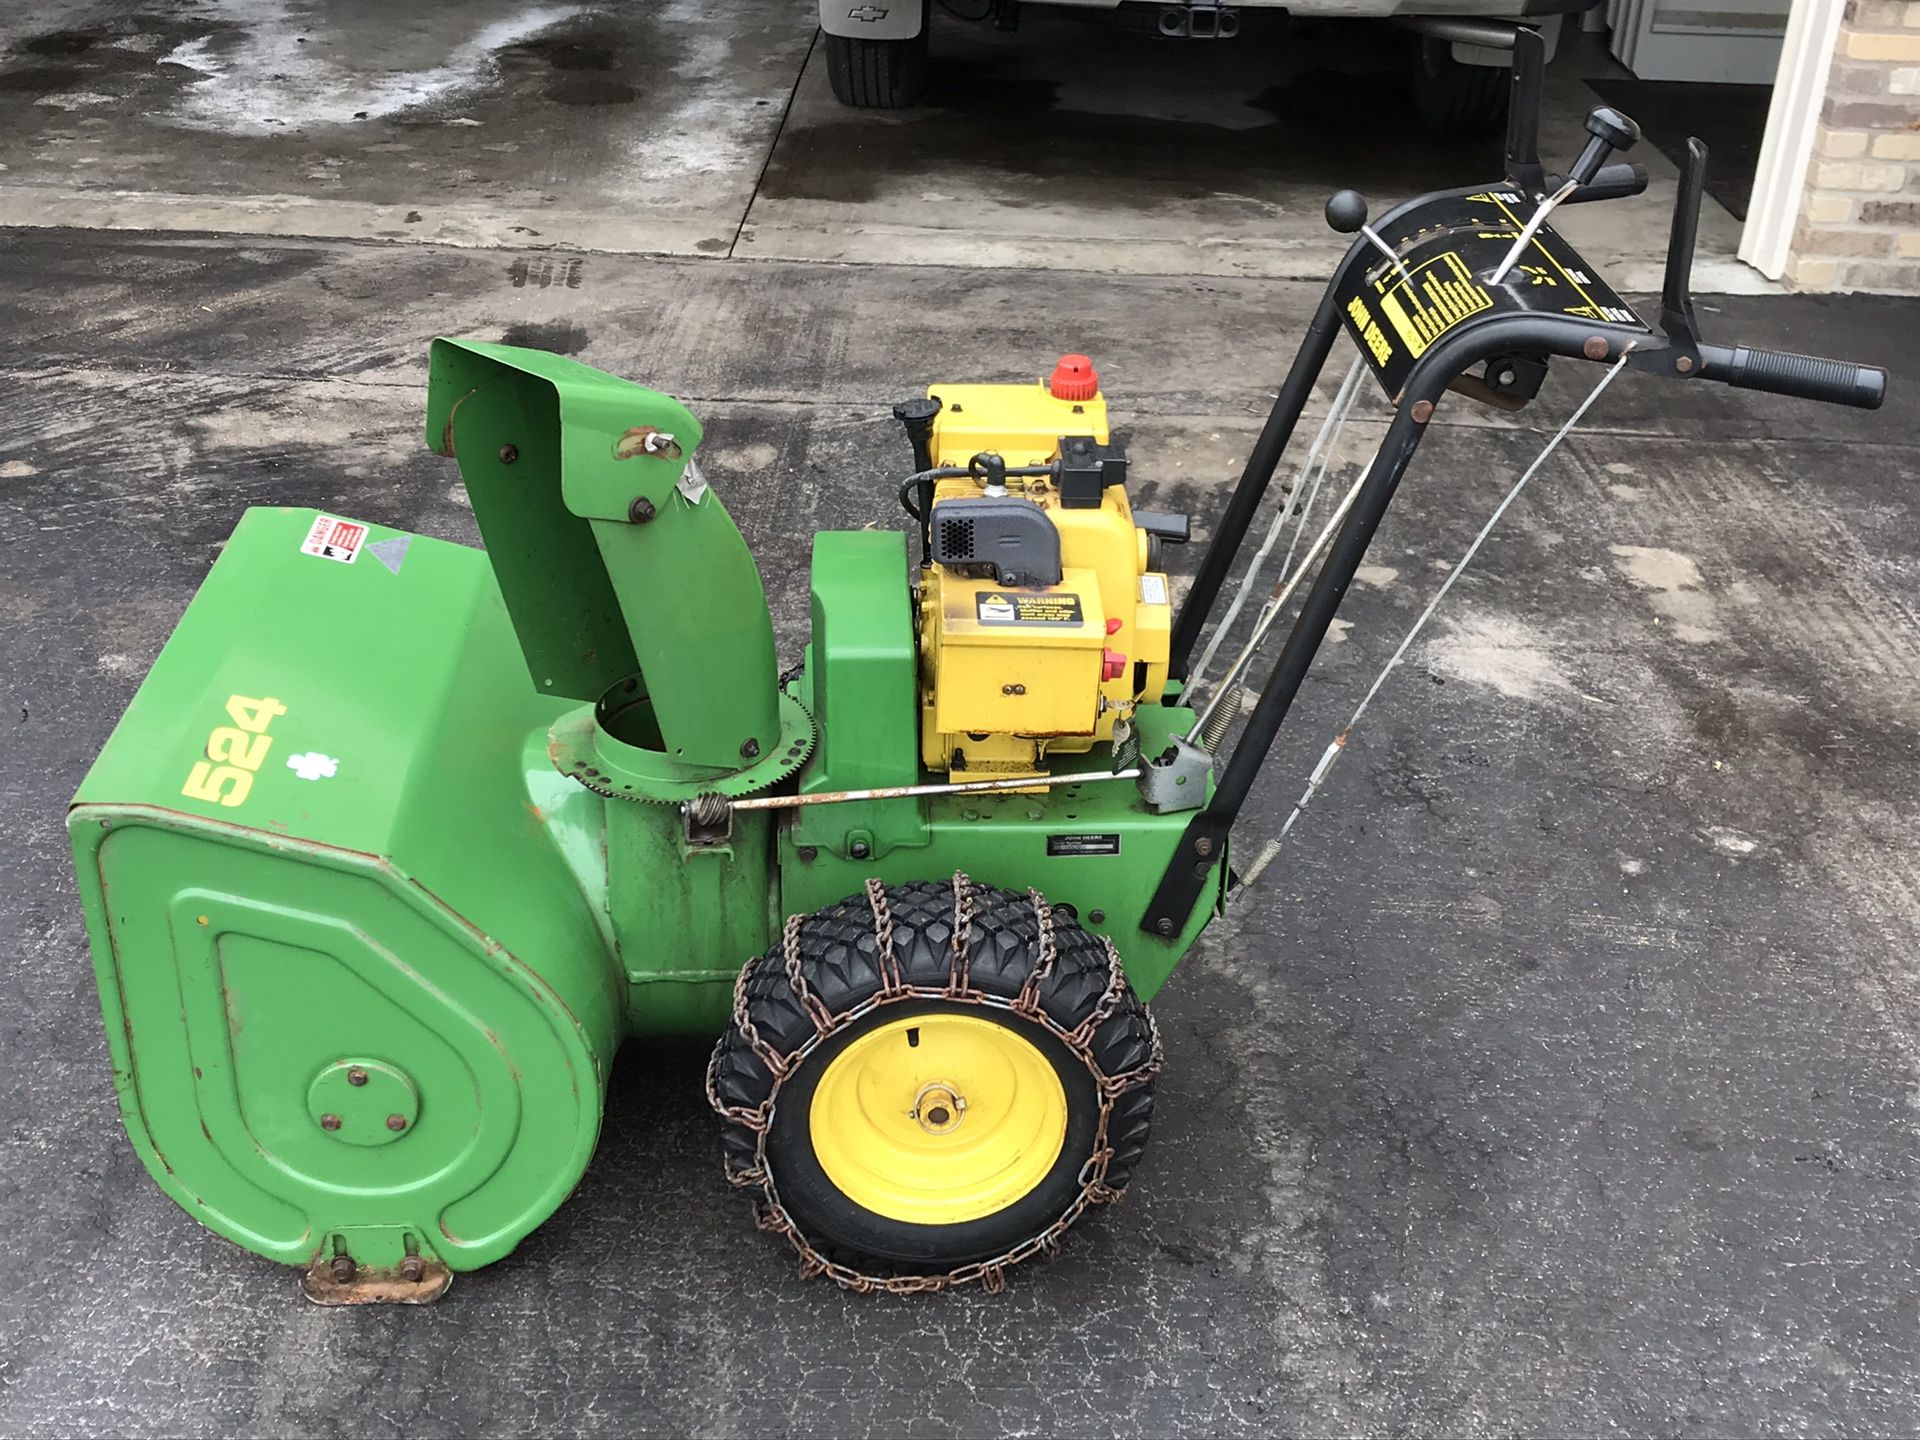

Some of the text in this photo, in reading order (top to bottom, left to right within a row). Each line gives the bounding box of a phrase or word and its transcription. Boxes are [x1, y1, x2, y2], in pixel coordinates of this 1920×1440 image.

[1361, 322, 1393, 368] DEERE
[1017, 597, 1075, 605] WARNING
[181, 695, 287, 807] 524
